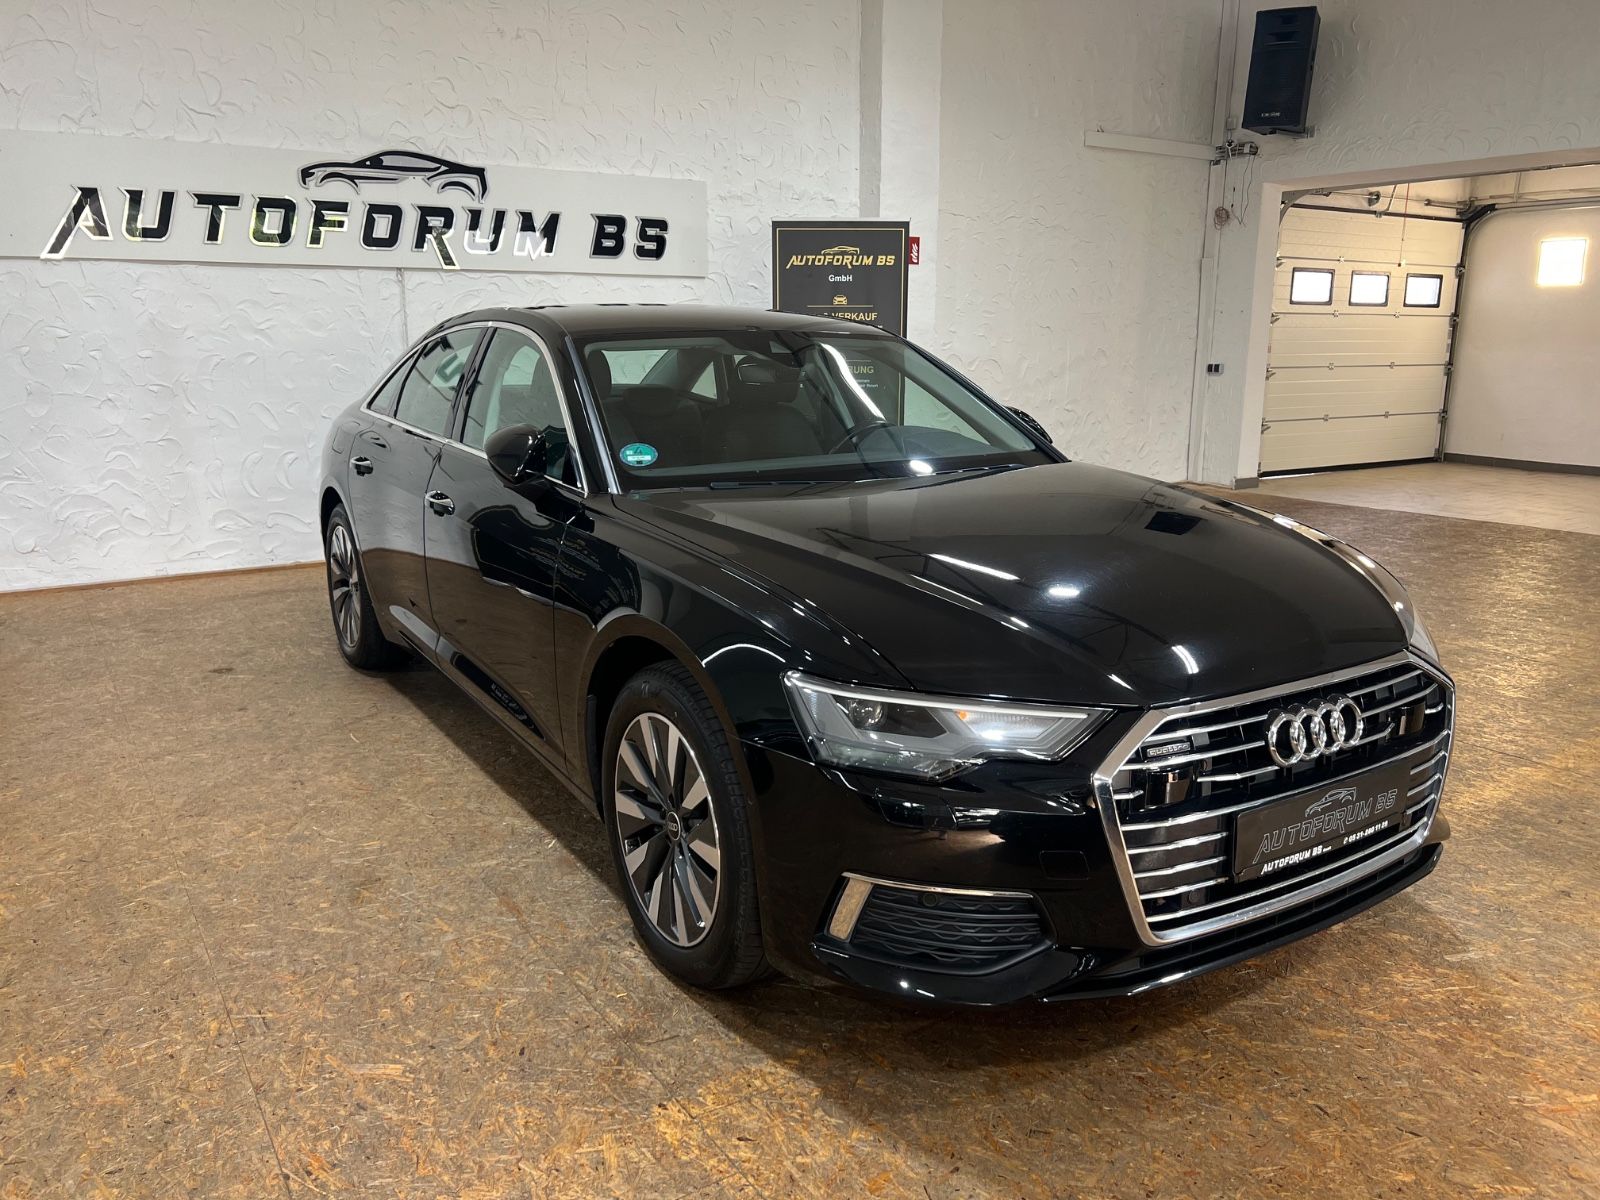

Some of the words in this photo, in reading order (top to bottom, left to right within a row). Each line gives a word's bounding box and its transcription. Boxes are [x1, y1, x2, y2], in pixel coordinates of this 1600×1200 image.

[41, 185, 563, 269] AUTOFORUM
[589, 213, 669, 262] BS
[786, 255, 873, 269] AUTOFORUM
[876, 255, 895, 266] BS
[828, 274, 853, 282] GmbH
[1252, 797, 1373, 864] AUTOFORUM
[1374, 788, 1398, 814] BS
[1261, 849, 1311, 875] AUTOFORUM
[1312, 844, 1323, 856] BS
